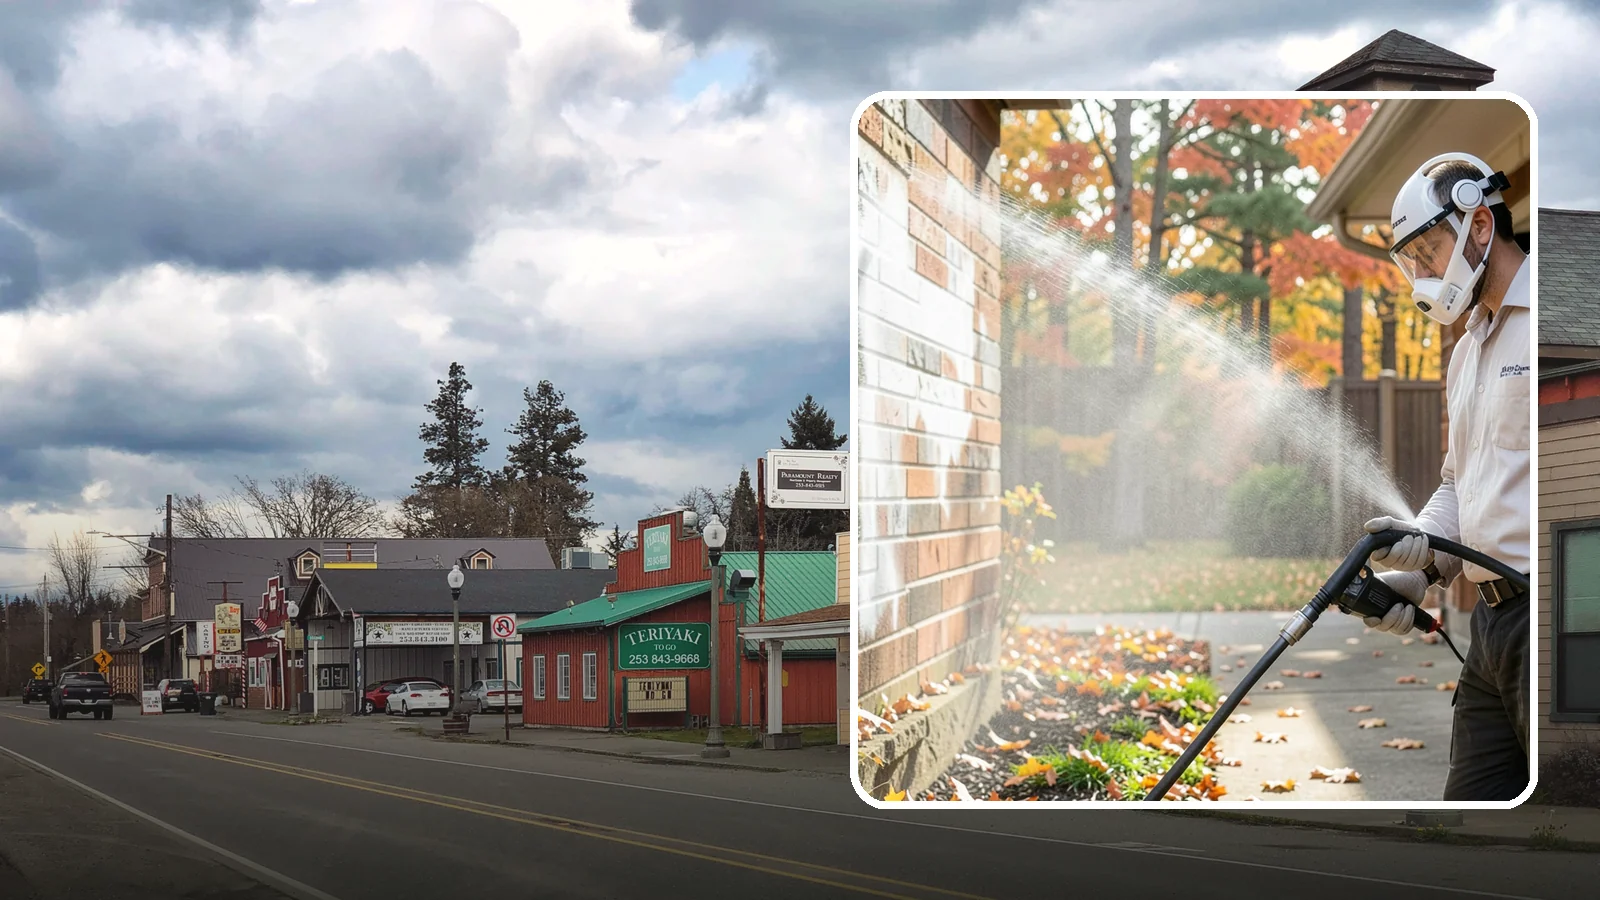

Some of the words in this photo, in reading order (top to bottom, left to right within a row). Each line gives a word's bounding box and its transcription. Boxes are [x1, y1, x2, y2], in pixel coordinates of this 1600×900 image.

[624, 627, 703, 646] TERIYAKI
[628, 654, 649, 665] 253
[651, 653, 700, 664] 843-9668
